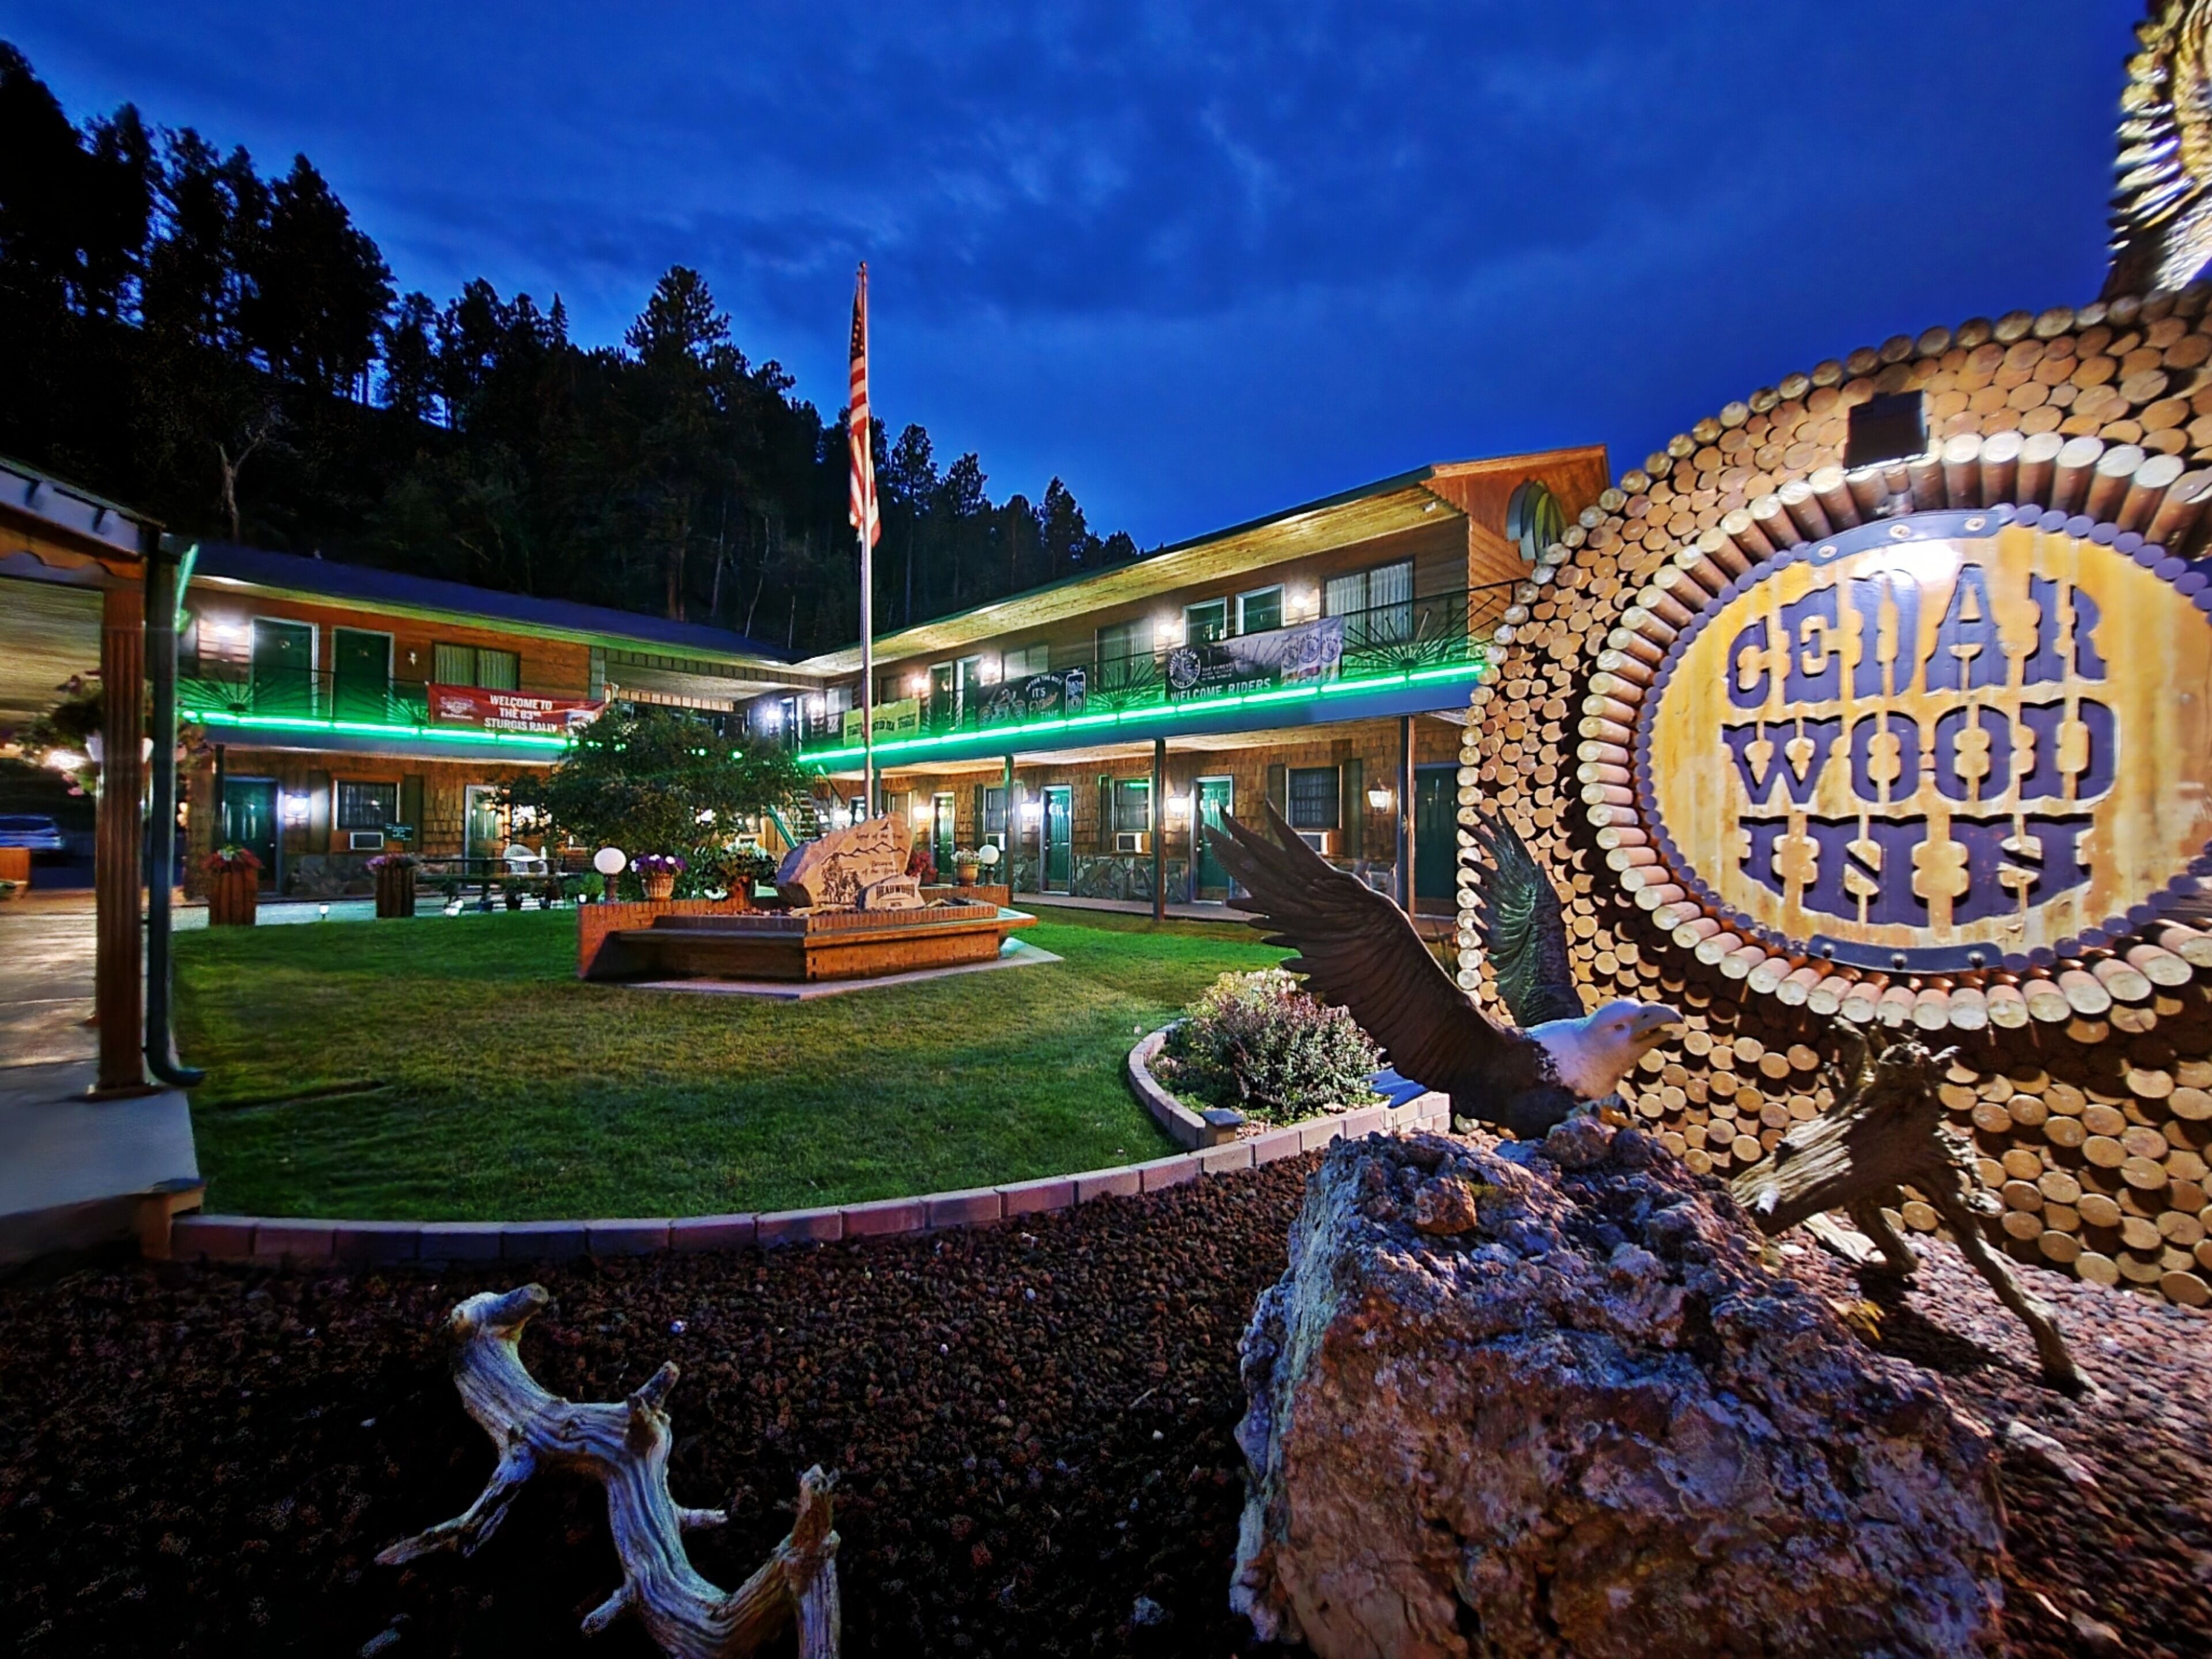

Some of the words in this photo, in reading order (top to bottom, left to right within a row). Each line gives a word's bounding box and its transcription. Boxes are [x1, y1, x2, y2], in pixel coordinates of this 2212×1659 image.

[1728, 563, 2107, 709] CEDAR
[1171, 685, 1223, 703] WELCOME
[1228, 677, 1271, 696] RIDERS
[490, 694, 539, 710] WELCOME
[540, 699, 553, 711] TO
[499, 707, 518, 719] THE
[484, 717, 528, 731] STURGIS
[529, 721, 558, 733] RALLY
[1721, 696, 2121, 805] WOOD
[1738, 813, 2093, 928] INN
[876, 884, 915, 900] DEADWOOD
